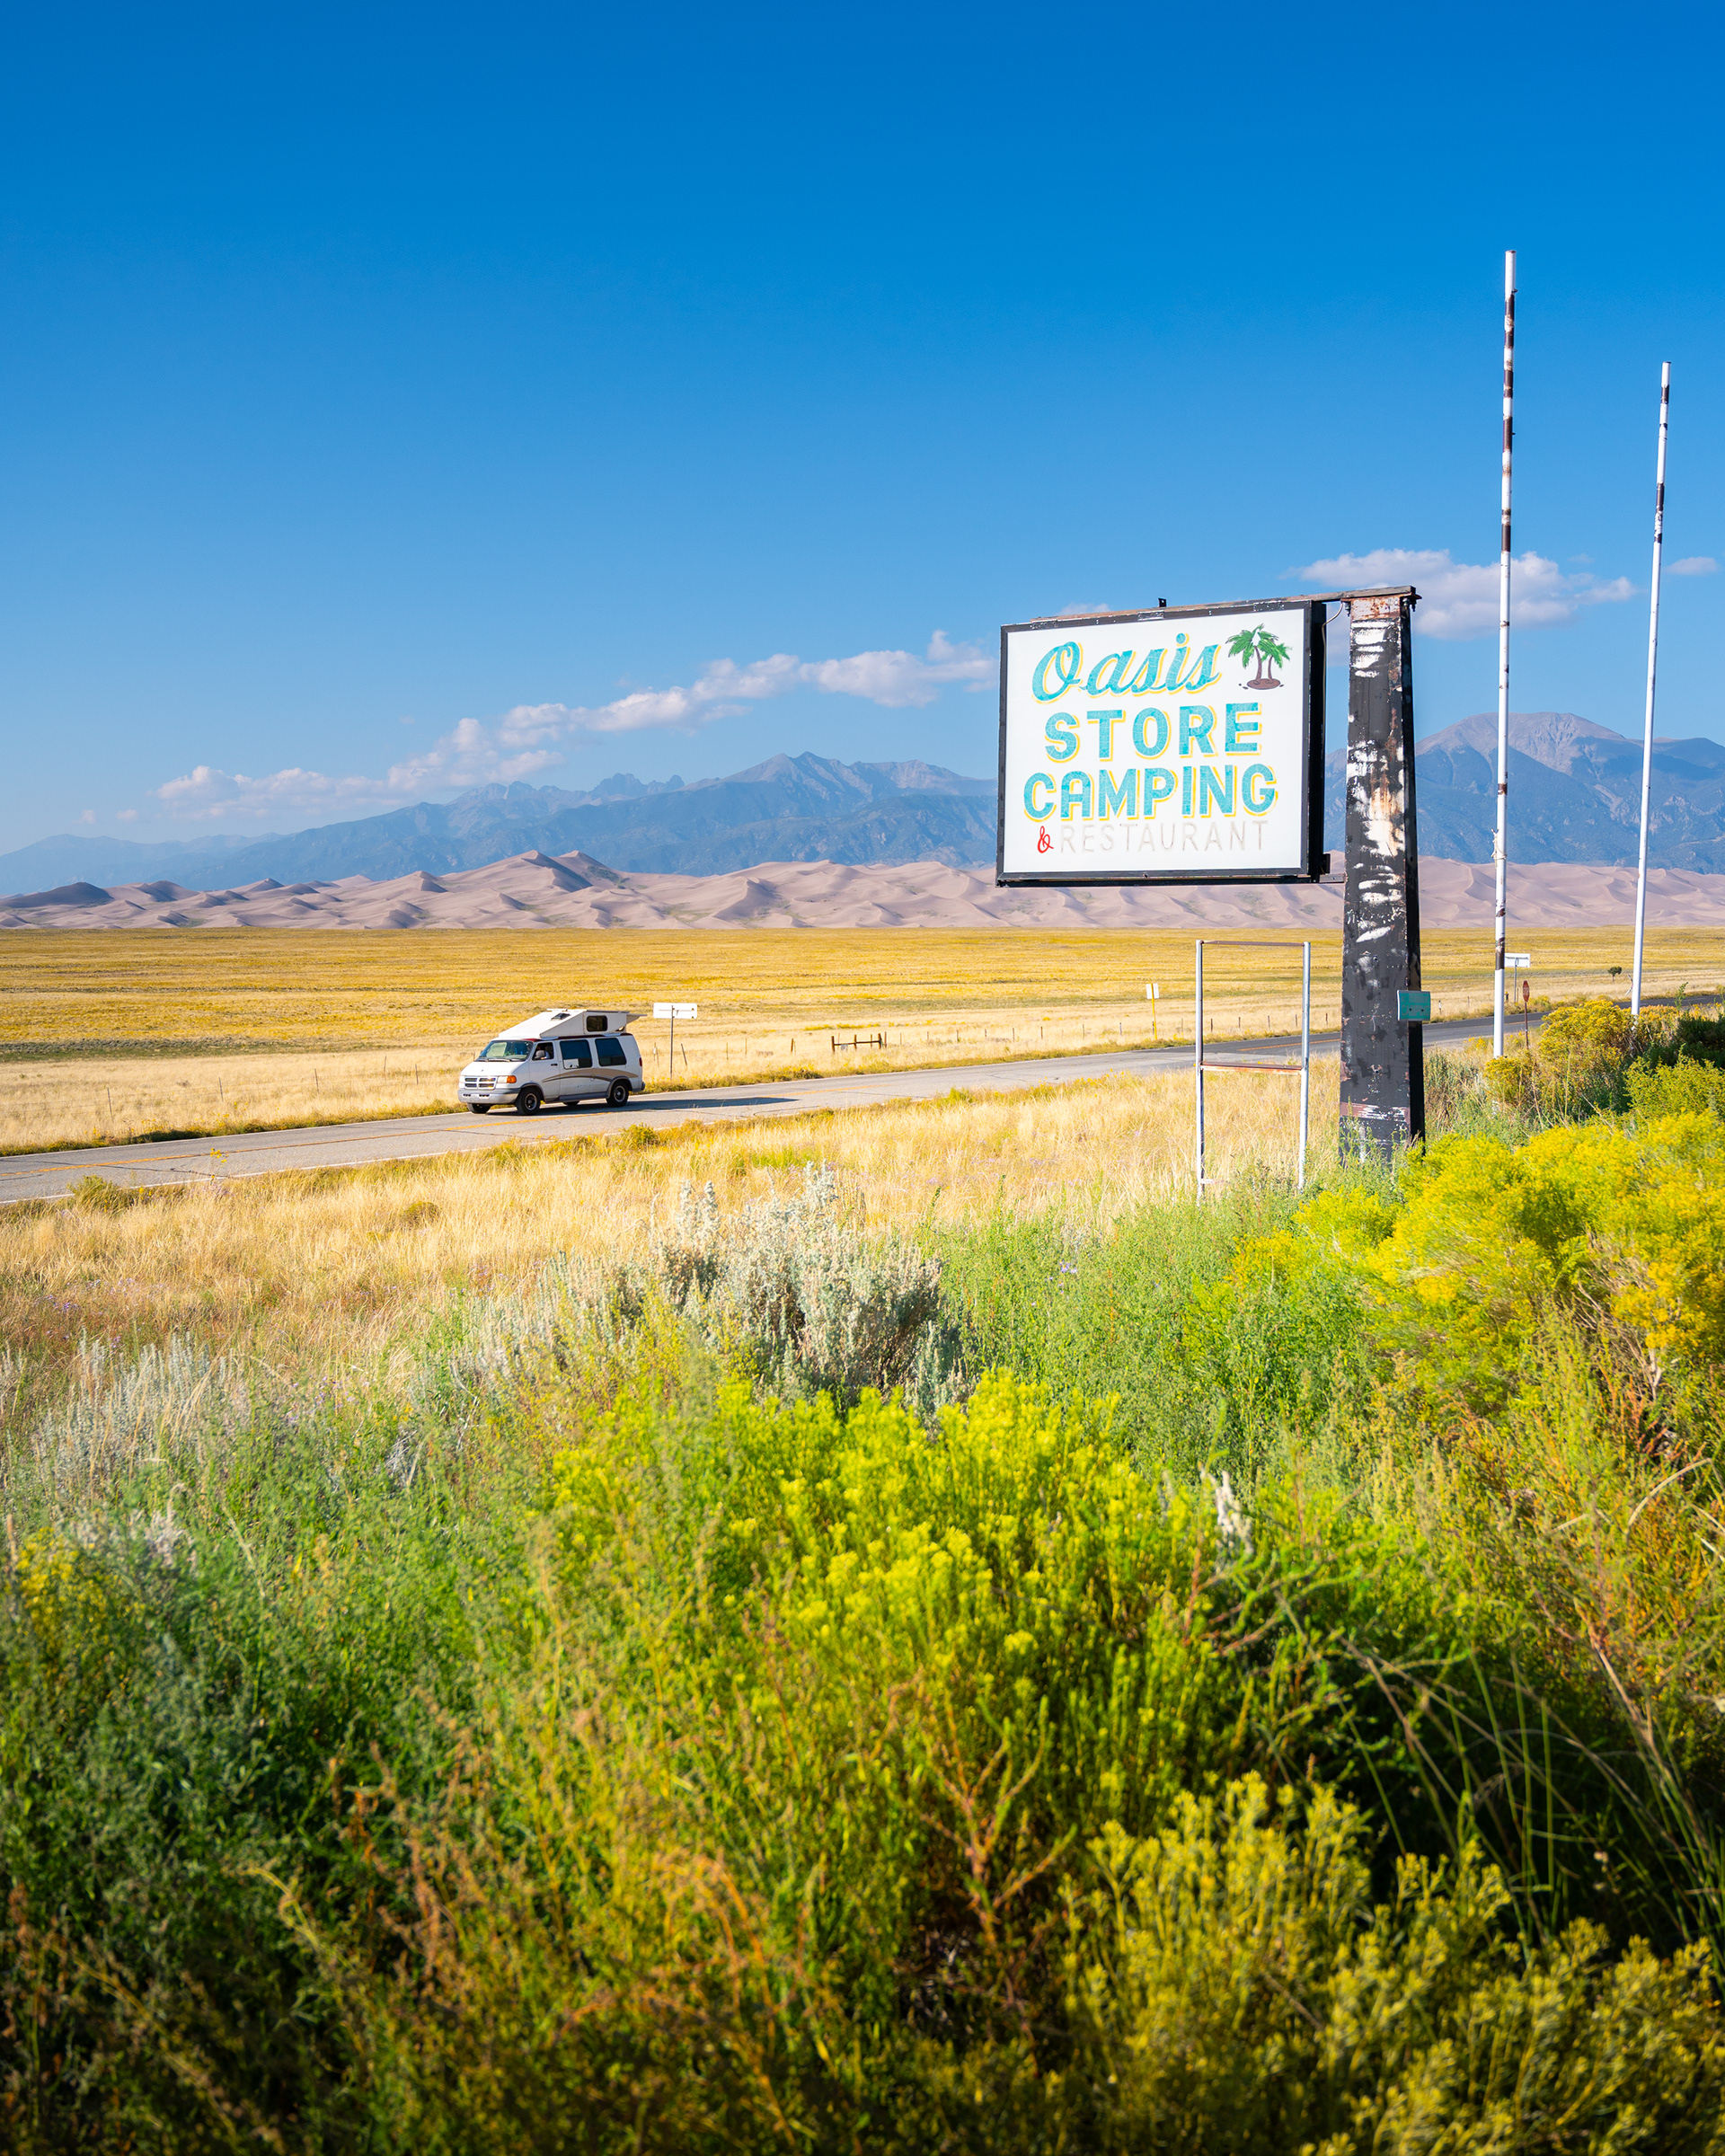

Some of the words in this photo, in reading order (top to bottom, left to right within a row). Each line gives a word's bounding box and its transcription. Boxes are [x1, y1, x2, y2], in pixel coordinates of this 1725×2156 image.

[1032, 633, 1222, 703] Oasis
[1045, 702, 1262, 764] STORE
[1023, 764, 1278, 822] CAMPING
[1037, 826, 1054, 853] &
[1060, 819, 1269, 853] RESTAURANT
